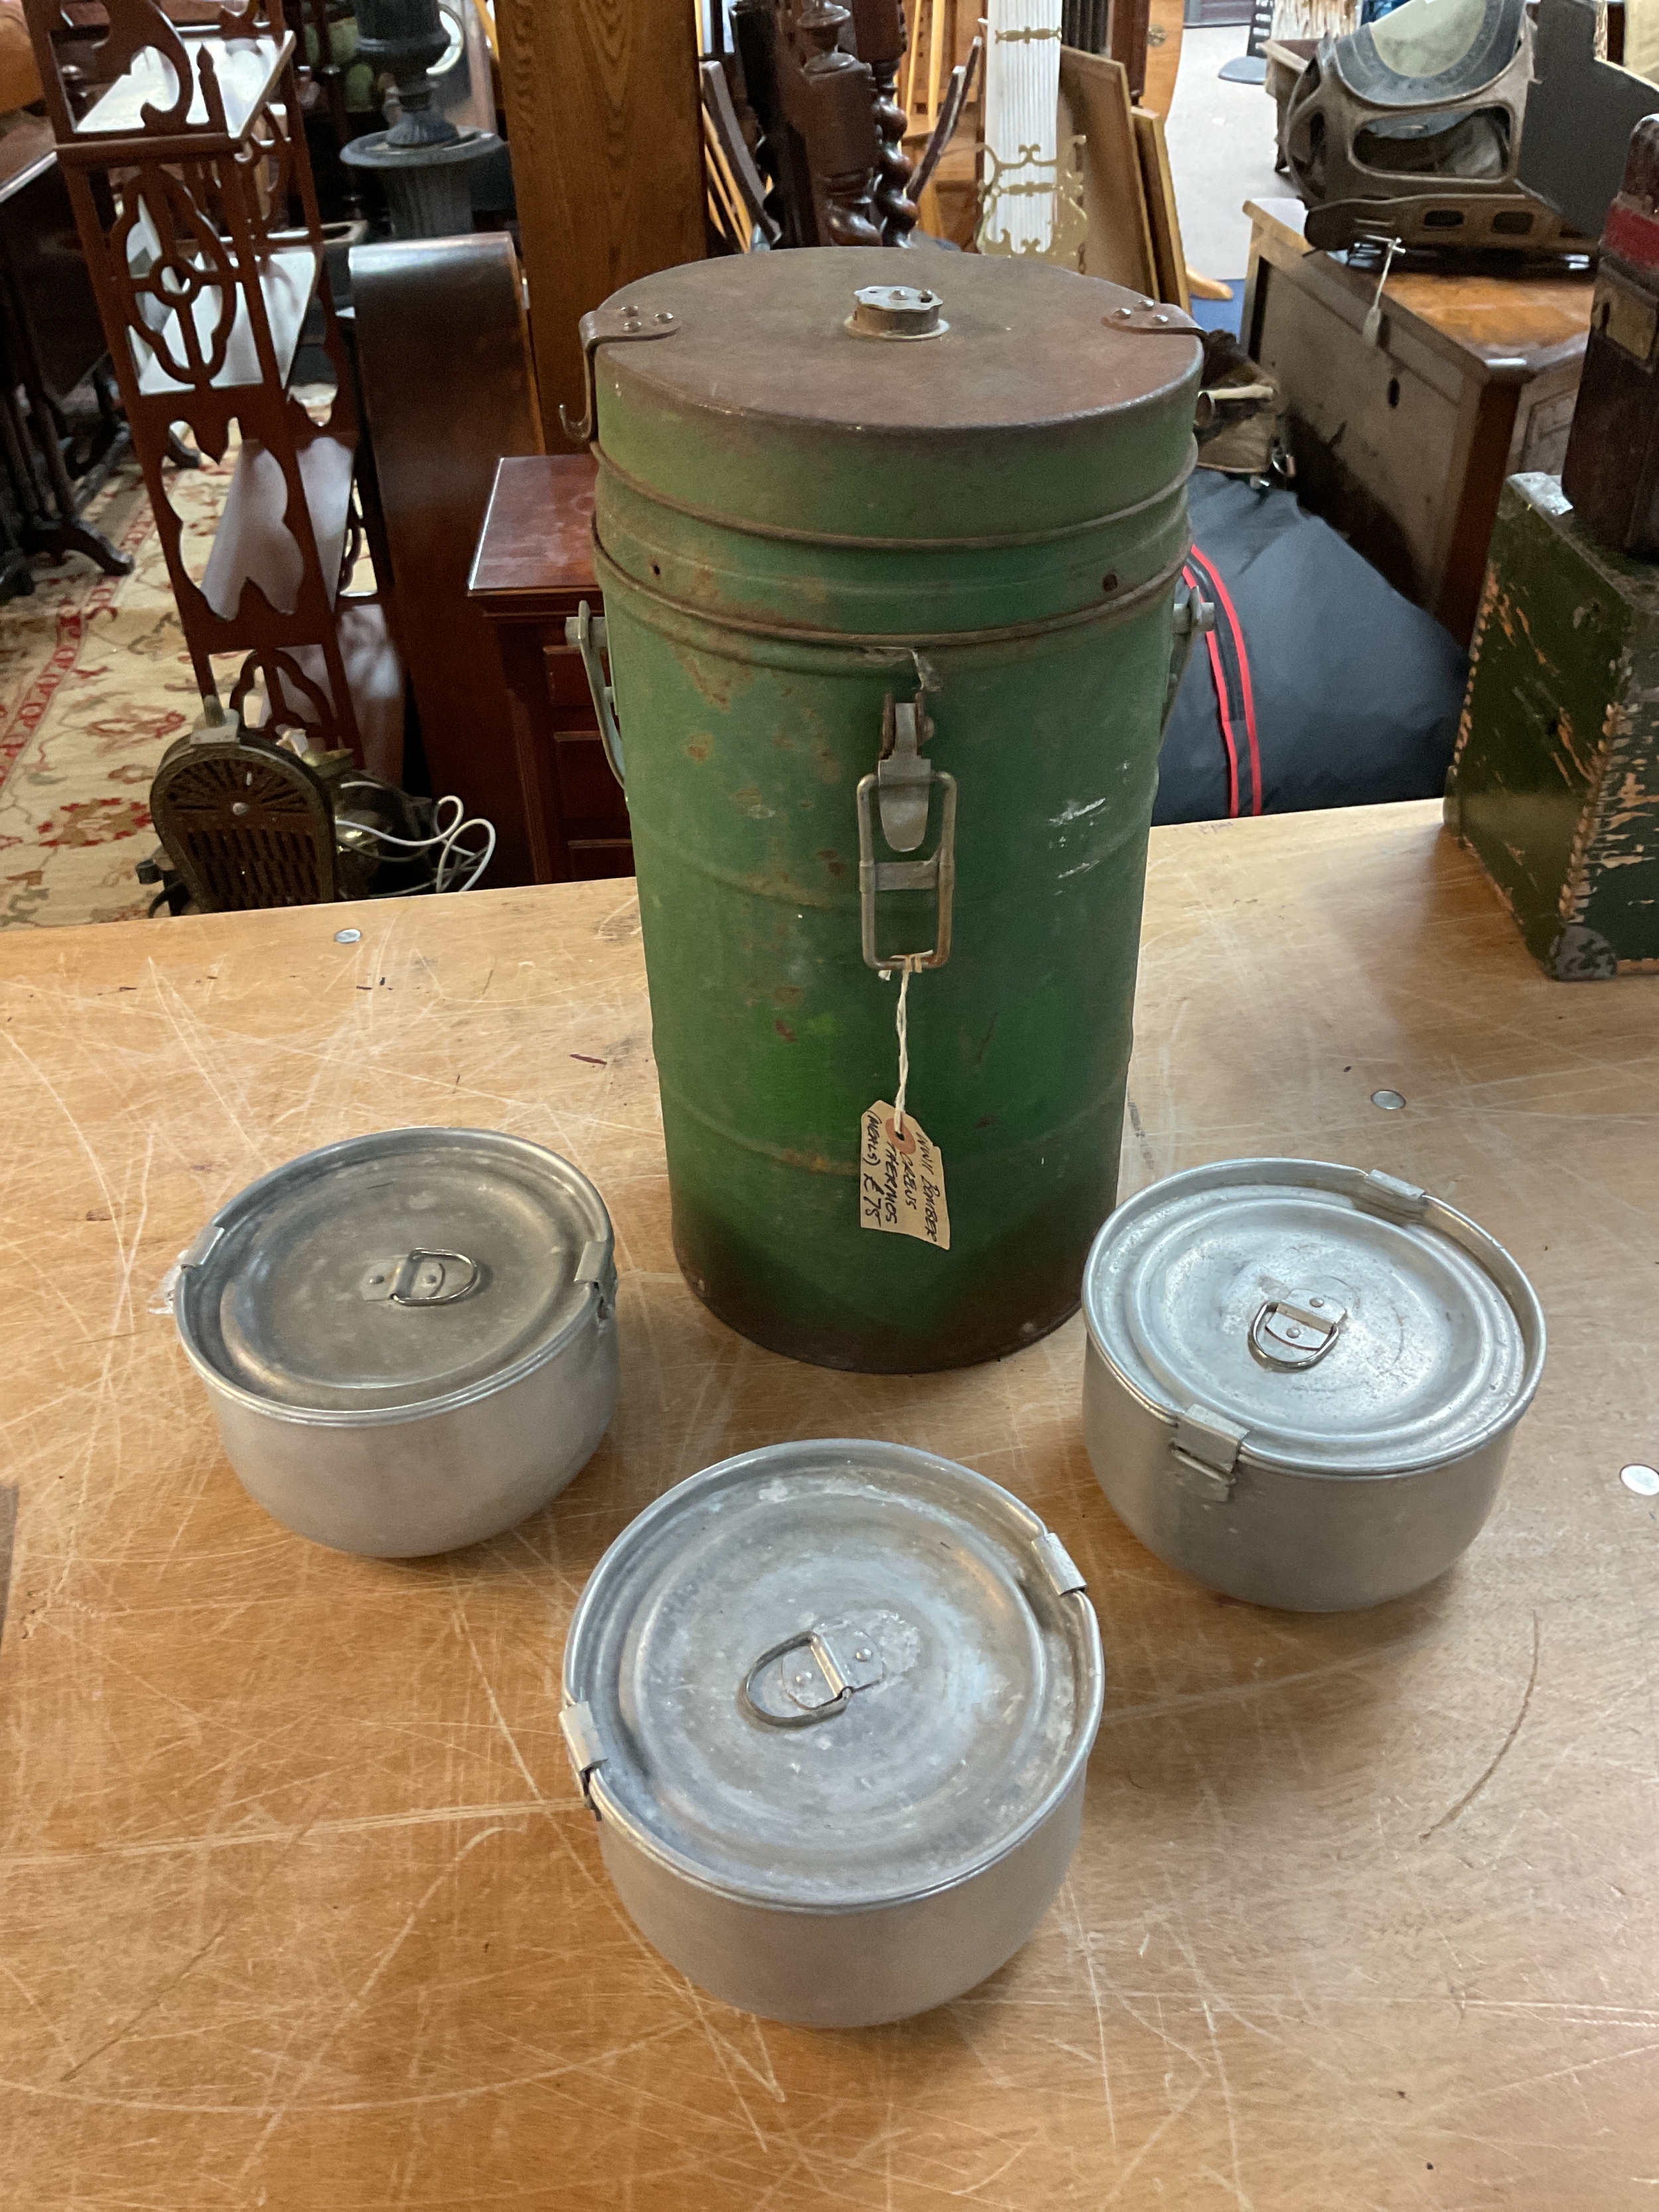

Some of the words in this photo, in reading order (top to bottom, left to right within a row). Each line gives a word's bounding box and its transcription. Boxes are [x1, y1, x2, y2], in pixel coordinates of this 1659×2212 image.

[863, 1110, 883, 1166] (MEALS)
[863, 1173, 885, 1227] £75
[884, 1141, 898, 1224] THERMOS
[900, 1152, 917, 1210] CREWS
